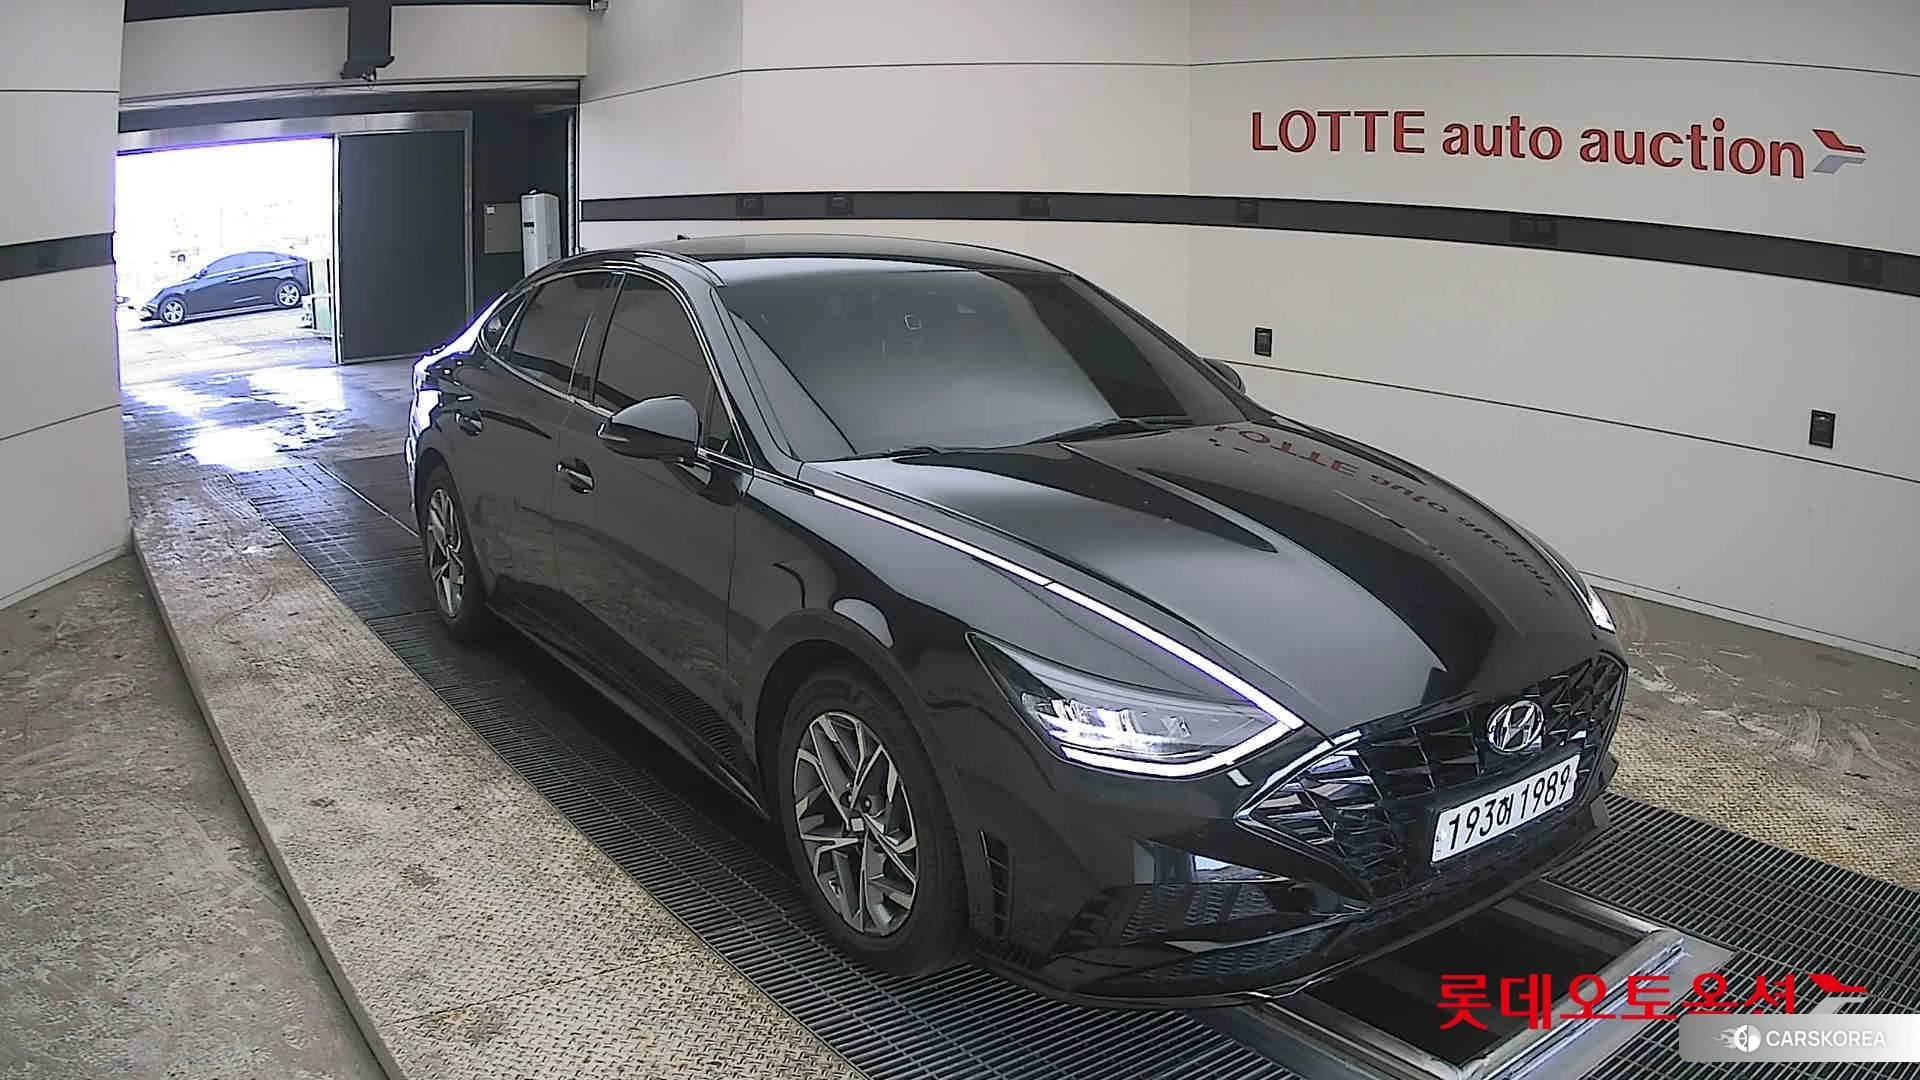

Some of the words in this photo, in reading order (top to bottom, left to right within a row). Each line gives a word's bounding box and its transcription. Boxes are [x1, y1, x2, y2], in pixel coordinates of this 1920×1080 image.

[1252, 111, 1425, 153] LOTTE
[1442, 115, 1562, 161] auto
[1579, 117, 1805, 179] auction
[1520, 764, 1571, 819] 1989
